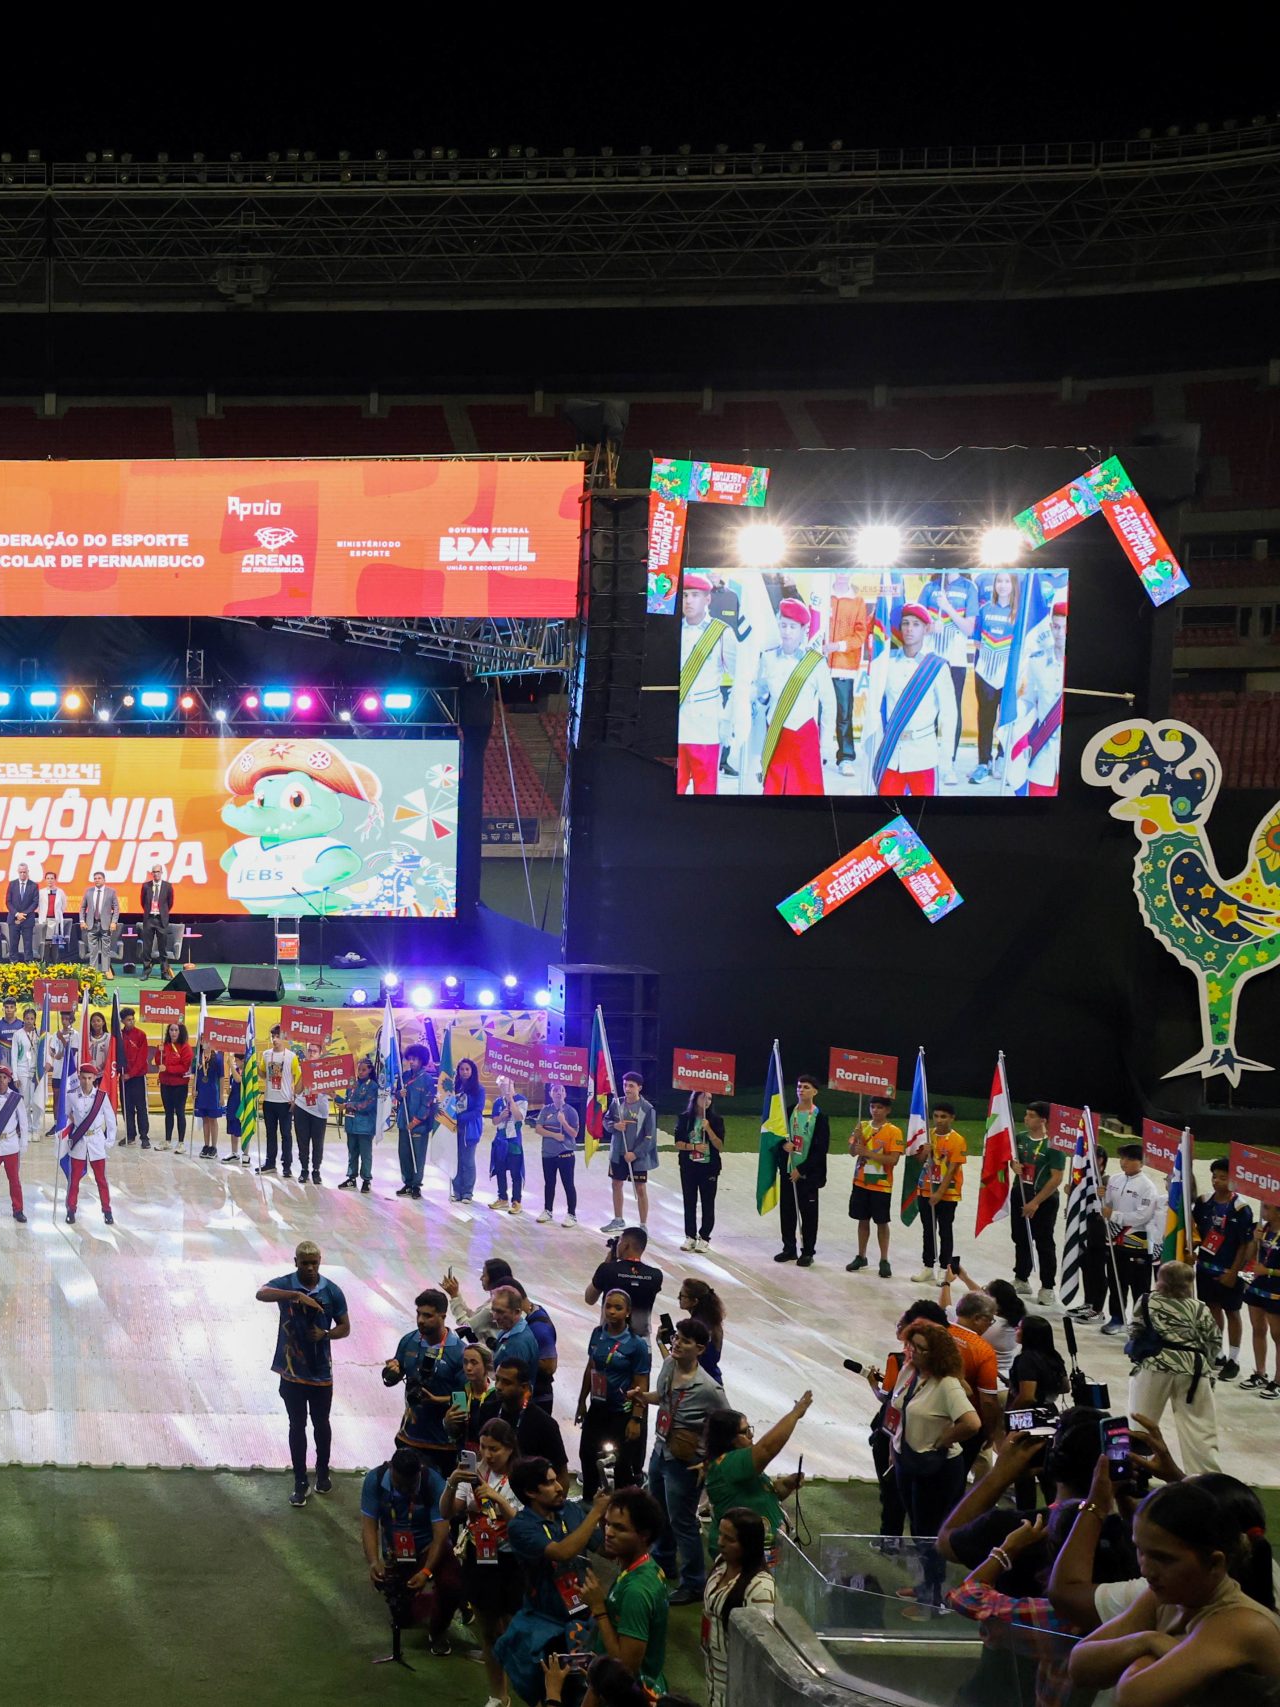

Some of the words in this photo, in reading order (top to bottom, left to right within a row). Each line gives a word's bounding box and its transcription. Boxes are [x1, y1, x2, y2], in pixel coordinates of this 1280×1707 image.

[227, 496, 281, 521] Apoio
[83, 534, 107, 546] DO
[112, 534, 189, 546] ESPORTE
[439, 537, 537, 562] BRASIL
[61, 555, 83, 567] DE
[87, 555, 205, 568] PERNAMBUCO
[242, 554, 304, 566] ARENA
[144, 1004, 180, 1015] Paraíba
[290, 1021, 322, 1035] Piauí
[209, 1031, 246, 1043] Paraná
[488, 1049, 503, 1060] Rio
[504, 1054, 535, 1069] Grande
[538, 1060, 552, 1069] Rio
[553, 1061, 583, 1072] Grande
[313, 1069, 330, 1079] Rio
[331, 1067, 344, 1076] de
[491, 1061, 503, 1070] do
[504, 1064, 529, 1078] Norte
[548, 1072, 559, 1080] do
[559, 1073, 573, 1081] Sul
[677, 1066, 729, 1081] Rondônia
[836, 1068, 889, 1086] Roraima
[311, 1078, 349, 1091] Janeiro
[1060, 1122, 1077, 1136] San
[1053, 1135, 1077, 1150] Catar
[1146, 1142, 1163, 1157] São
[1235, 1165, 1280, 1193] Sergip
